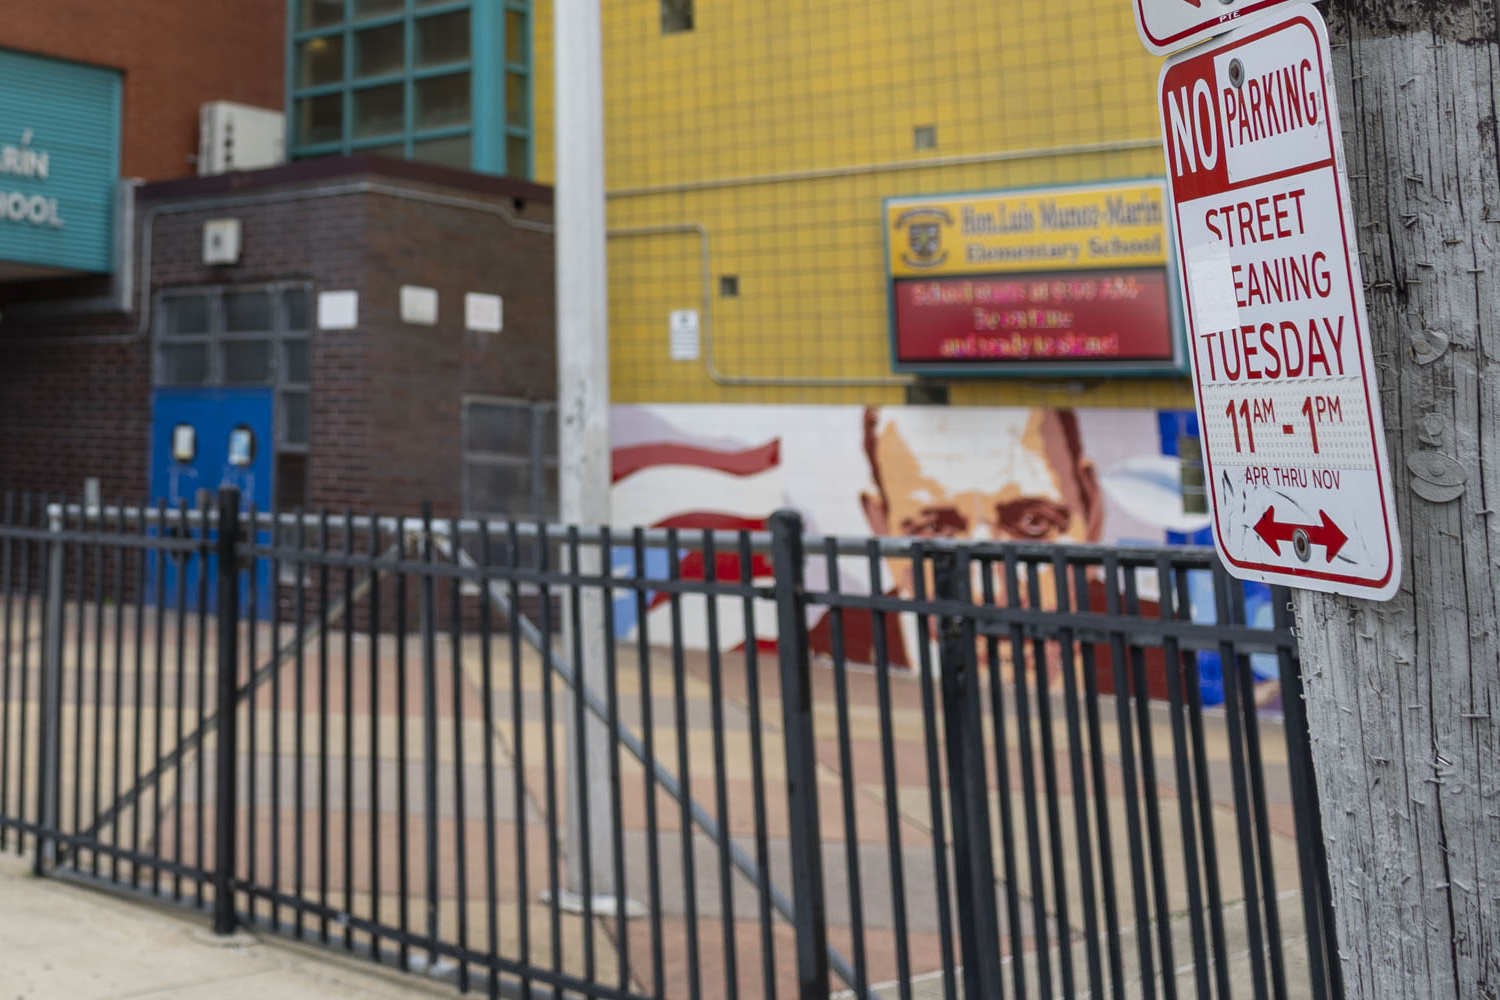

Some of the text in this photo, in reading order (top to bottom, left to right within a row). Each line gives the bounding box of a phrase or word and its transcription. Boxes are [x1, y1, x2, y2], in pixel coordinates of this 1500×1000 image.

[1219, 10, 1241, 23] PTE
[1167, 58, 1318, 177] NO PARKING
[1205, 188, 1306, 247] STREET
[965, 239, 1081, 264] Elementary
[1087, 233, 1161, 258] School
[1231, 251, 1332, 308] EANING
[1200, 315, 1344, 381] TUESDAY
[1225, 398, 1276, 453] 11AM
[1245, 466, 1340, 490] APR THRU NOV
